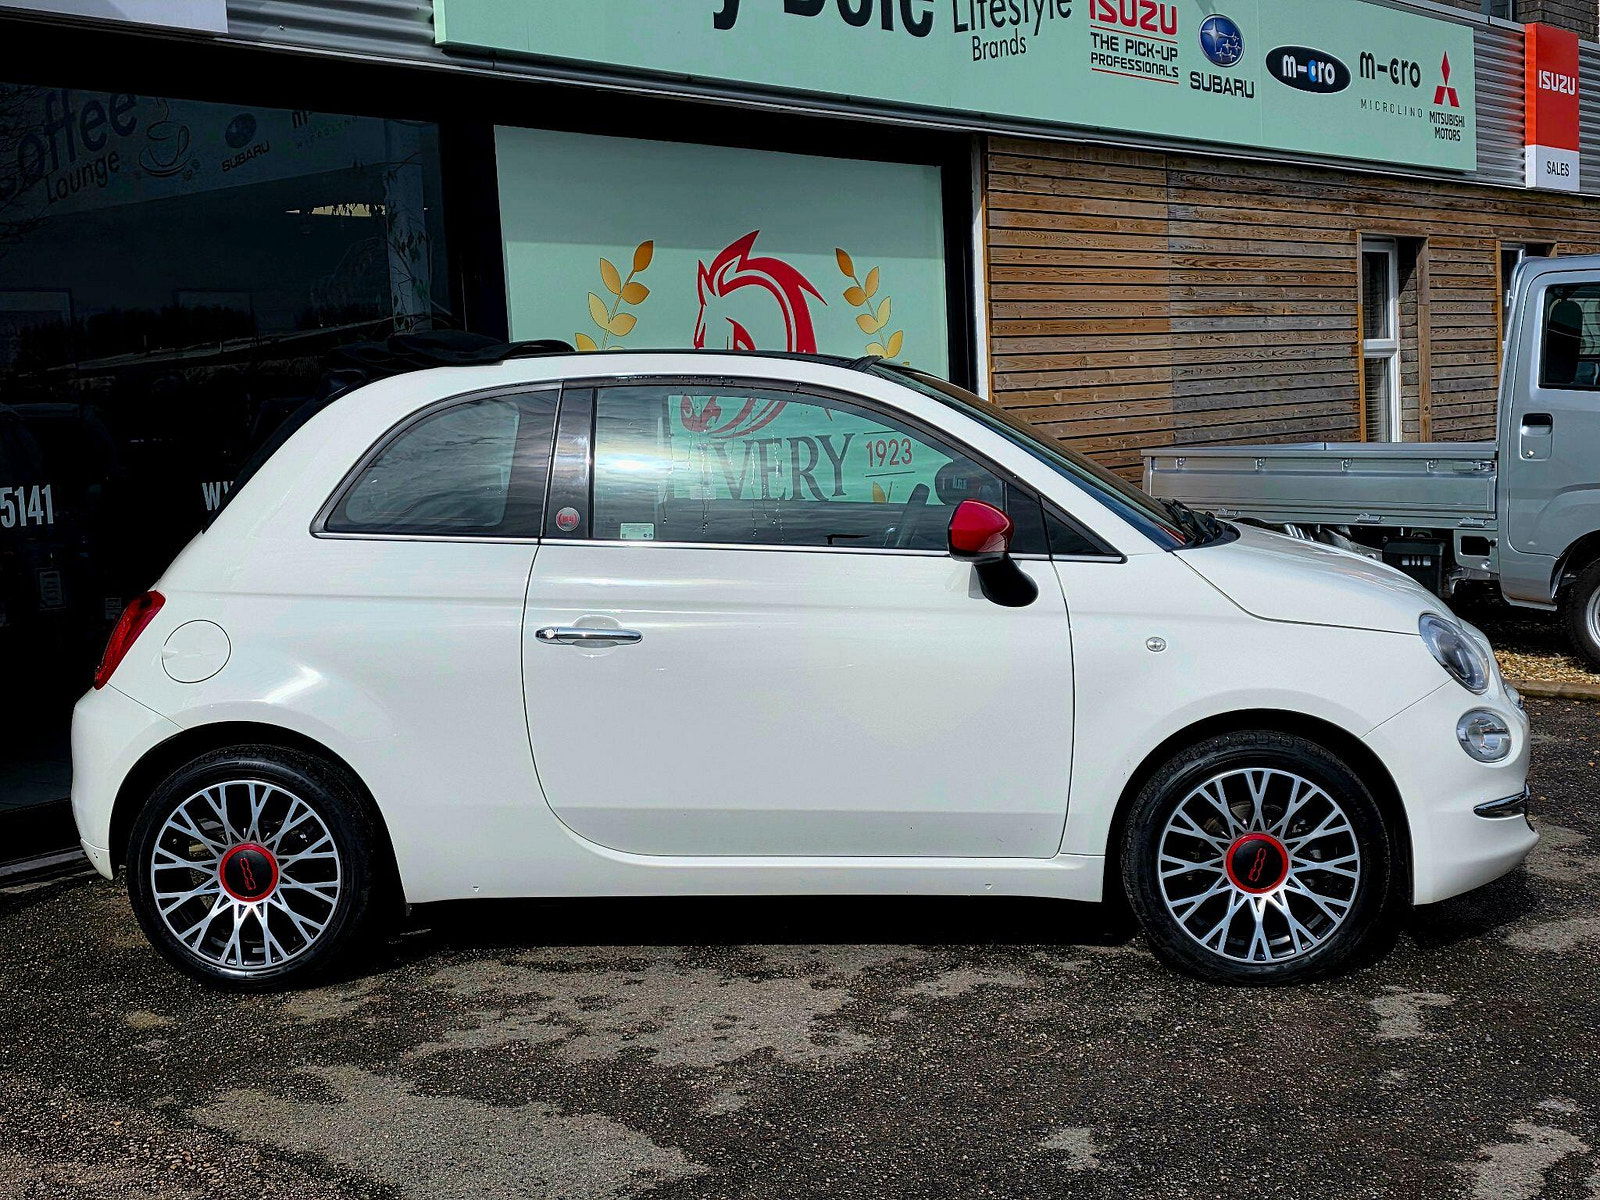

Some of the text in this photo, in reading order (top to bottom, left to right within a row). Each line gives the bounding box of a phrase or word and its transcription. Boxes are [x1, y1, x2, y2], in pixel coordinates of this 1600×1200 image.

[1089, 0, 1178, 35] ISUZU
[972, 28, 1027, 61] Brands
[1090, 32, 1178, 62] THE PICK-UP
[1090, 52, 1179, 78] PROFESSIONALS
[1190, 71, 1254, 99] SUBARU
[1539, 70, 1575, 95] ISUZU
[1360, 98, 1423, 118] MICROLINO
[1429, 111, 1465, 128] MITSUBISHI
[1434, 126, 1461, 141] MOTORS
[221, 140, 271, 172] SUBARU
[1547, 160, 1570, 177] SALES
[46, 151, 120, 204] Lounge
[865, 438, 913, 467] 1923
[0, 484, 54, 528] 5141
